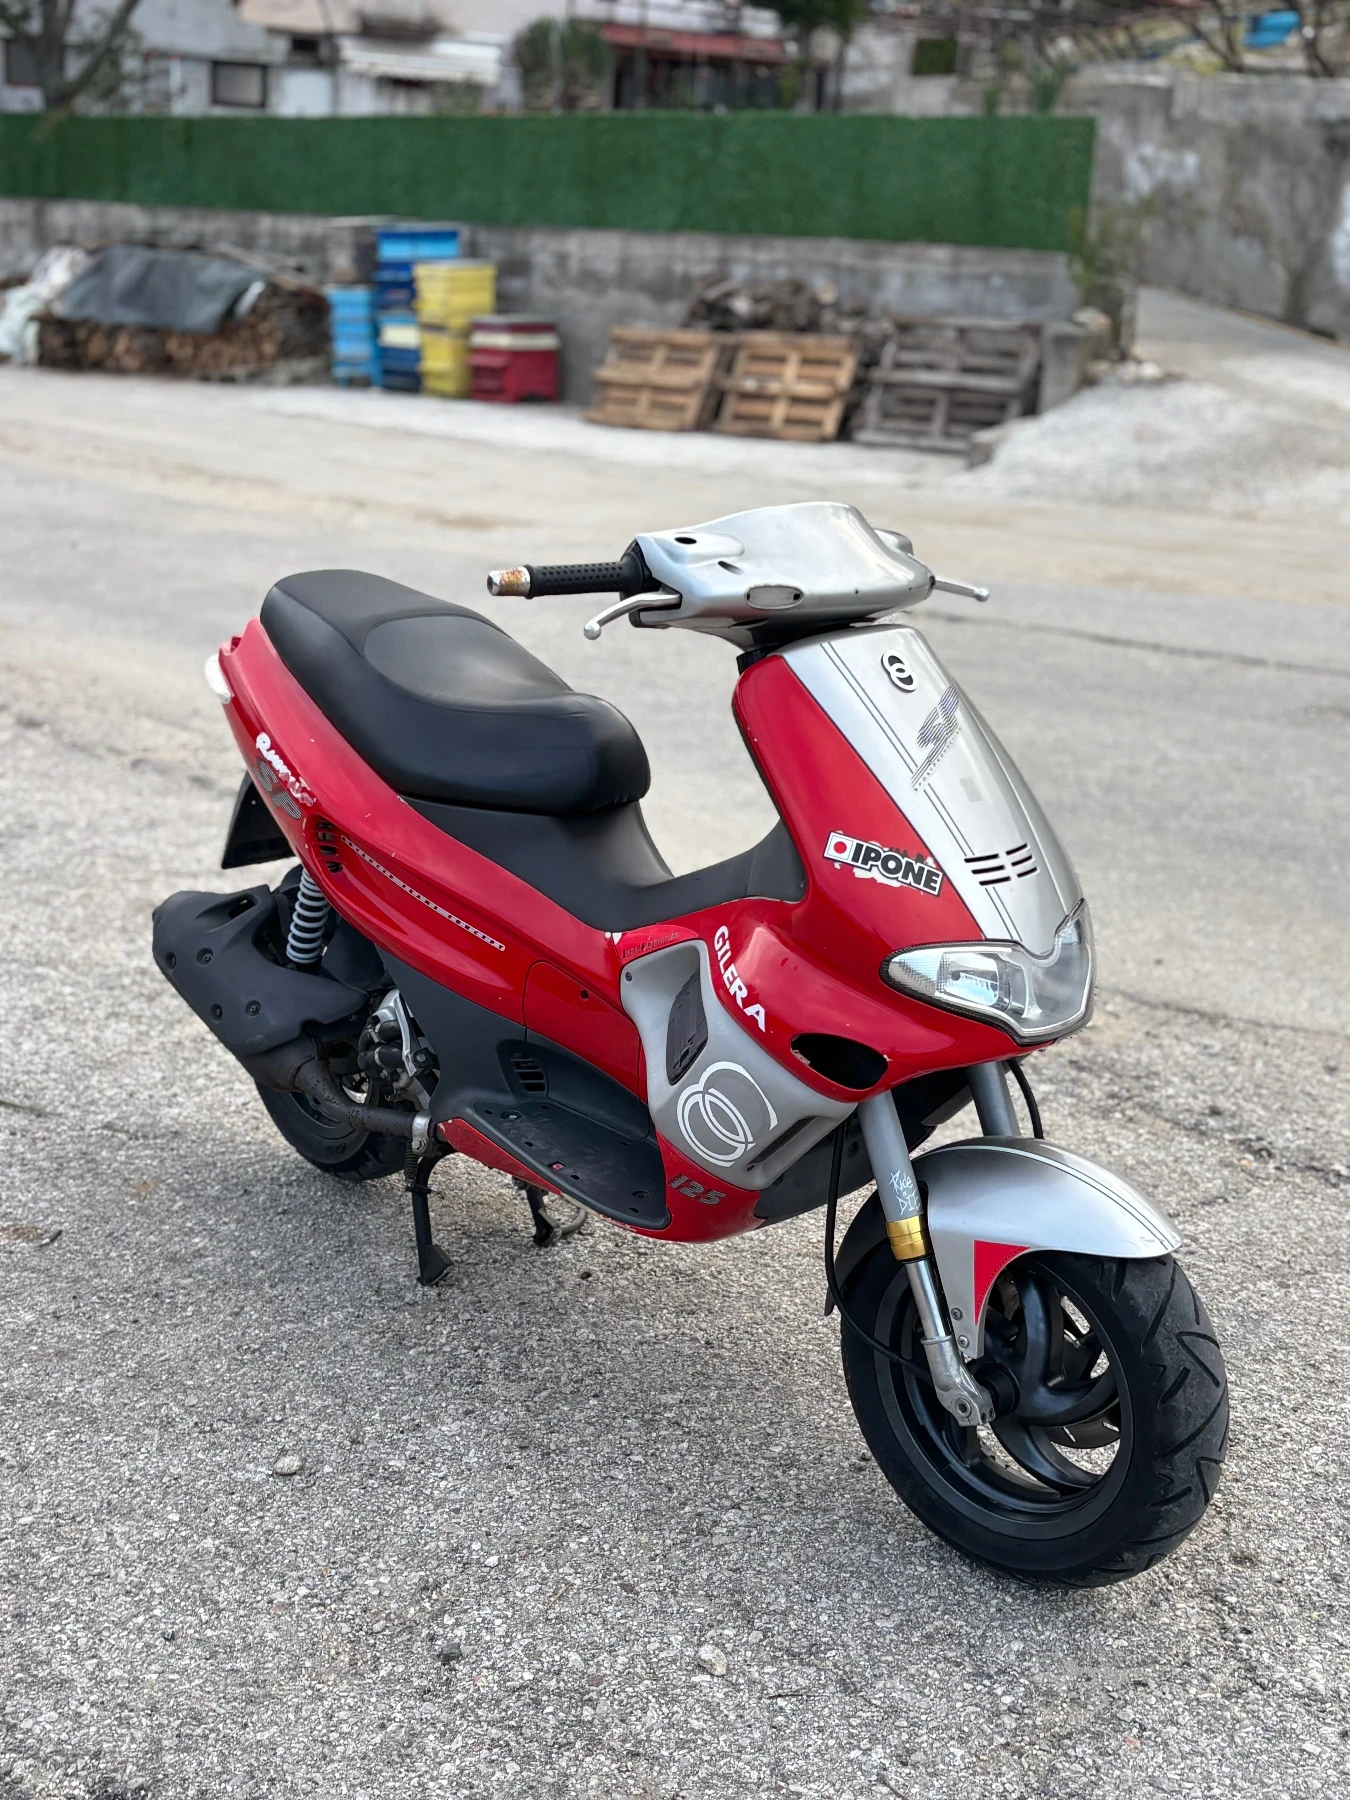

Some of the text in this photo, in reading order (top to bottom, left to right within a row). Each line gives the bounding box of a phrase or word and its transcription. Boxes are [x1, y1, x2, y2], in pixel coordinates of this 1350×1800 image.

[850, 842, 941, 892] IPONE
[447, 914, 504, 949] CONCEPT
[714, 925, 767, 1033] GILERA
[668, 1173, 727, 1206] 125
[895, 1188, 921, 1216] DIE
